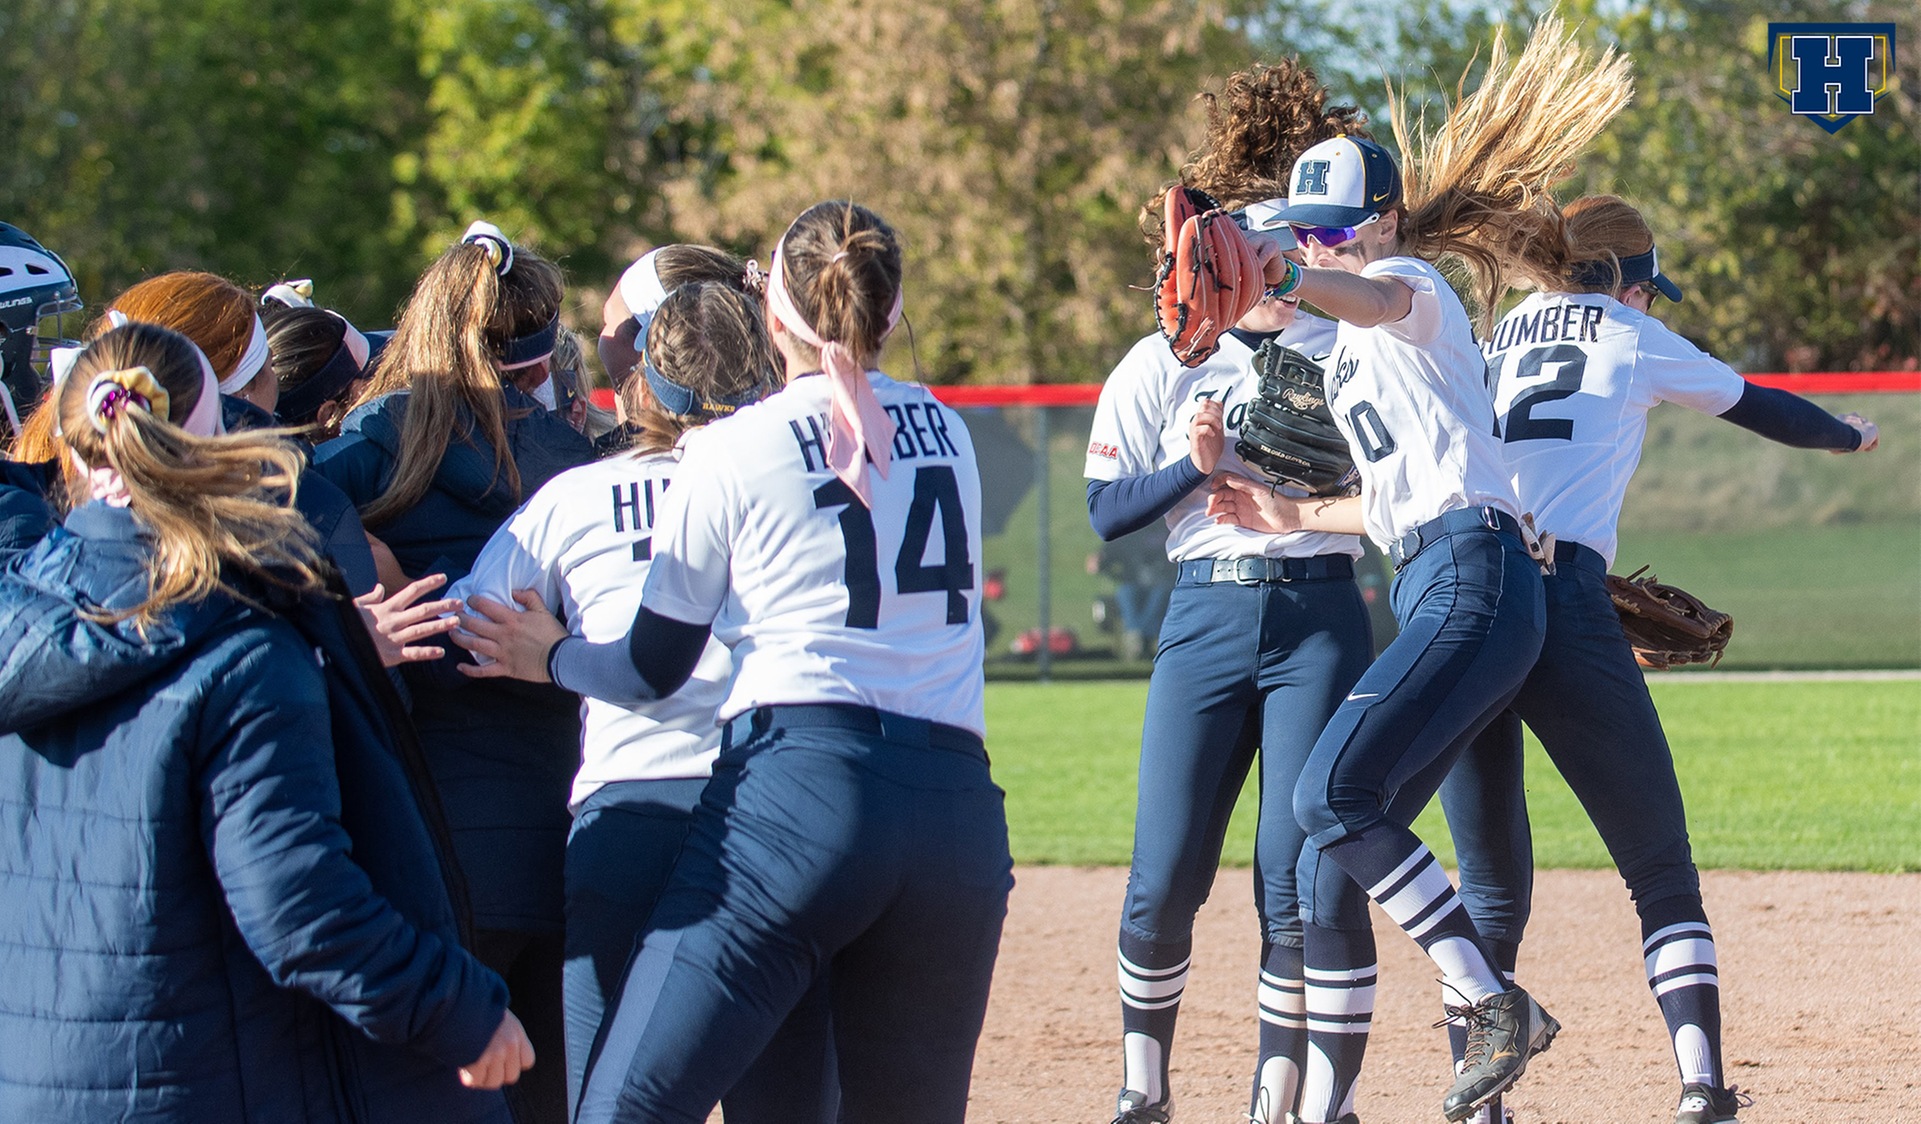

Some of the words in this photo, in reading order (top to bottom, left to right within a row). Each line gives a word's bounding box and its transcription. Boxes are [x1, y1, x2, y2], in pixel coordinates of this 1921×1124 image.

[1296, 160, 1331, 195] H
[702, 402, 736, 412] HAWKS
[788, 402, 960, 472] HBER
[812, 464, 975, 630] 14
